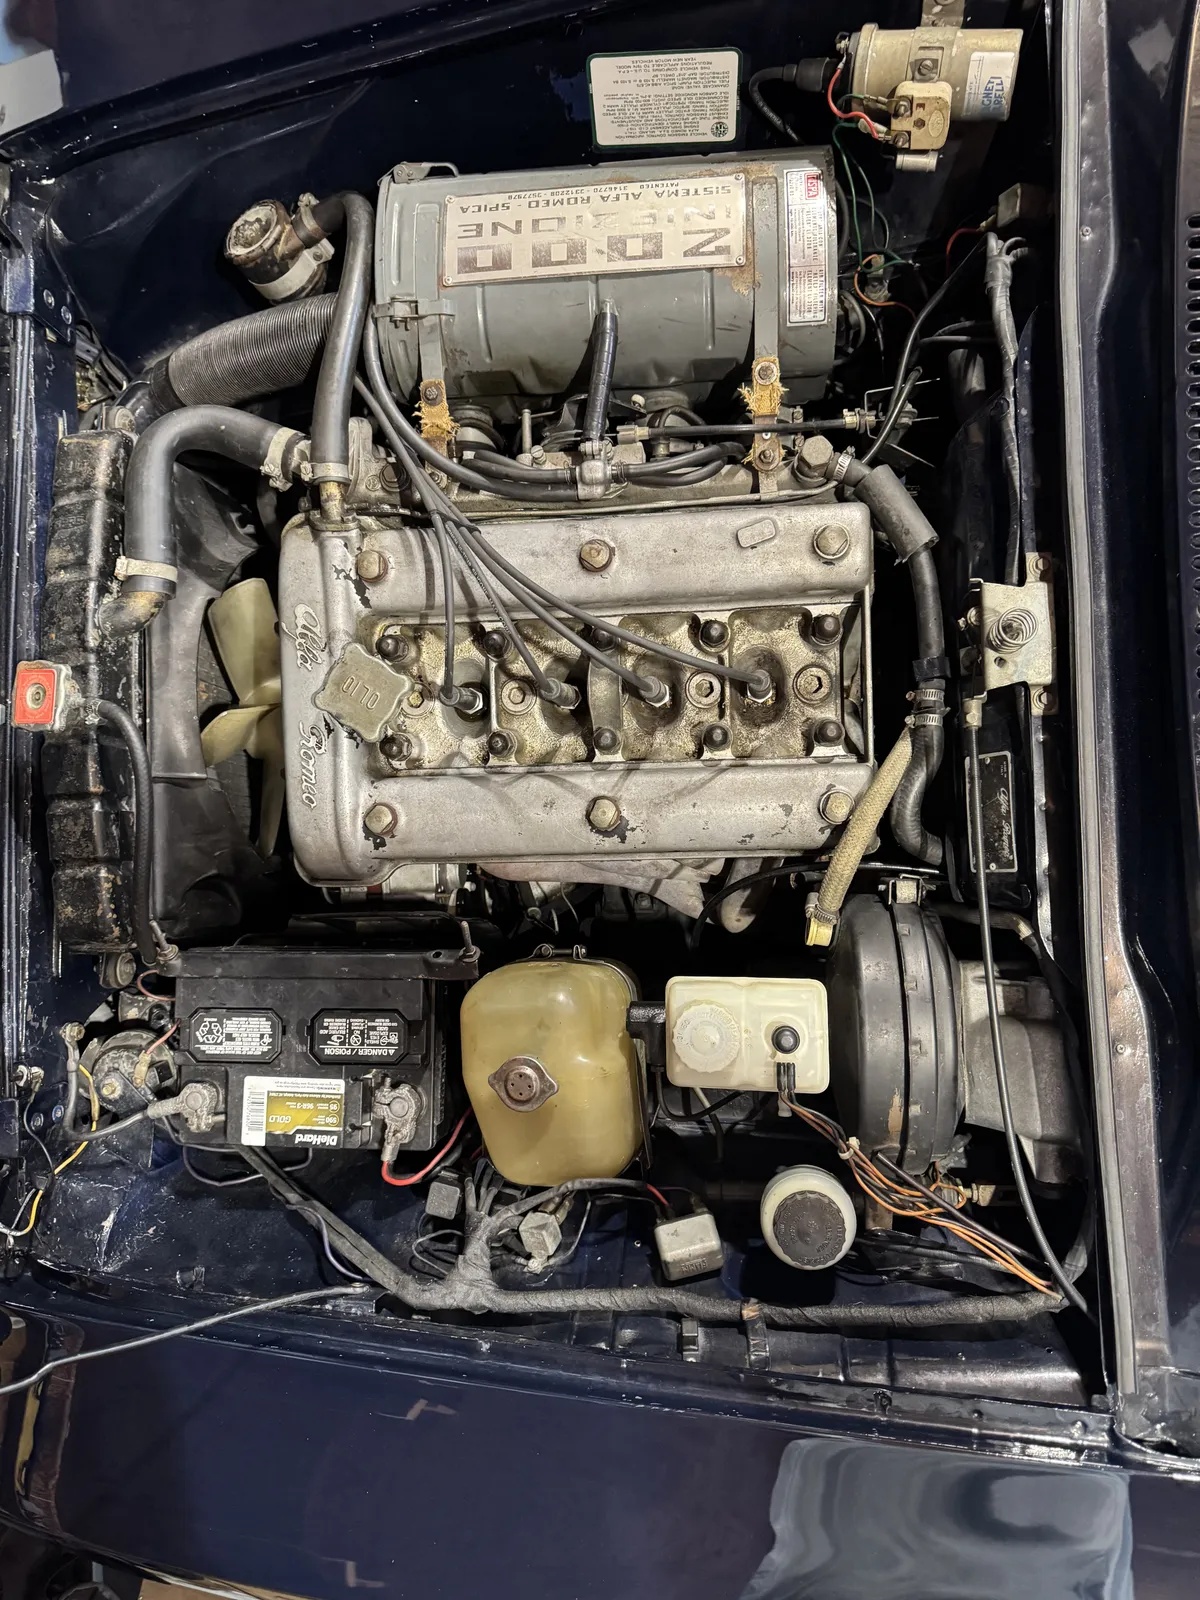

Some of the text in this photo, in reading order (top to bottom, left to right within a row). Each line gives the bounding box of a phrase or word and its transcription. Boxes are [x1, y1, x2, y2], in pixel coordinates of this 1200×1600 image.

[639, 182, 680, 190] PATENTED
[654, 185, 731, 200] SISTEMA
[528, 196, 590, 209] ROMEO
[599, 191, 642, 204] ALFA
[459, 202, 511, 214] SPICA
[282, 603, 323, 672] Alfa
[342, 676, 380, 711] OLIO
[300, 722, 329, 809] Romeo
[295, 1134, 338, 1146] DieHard
